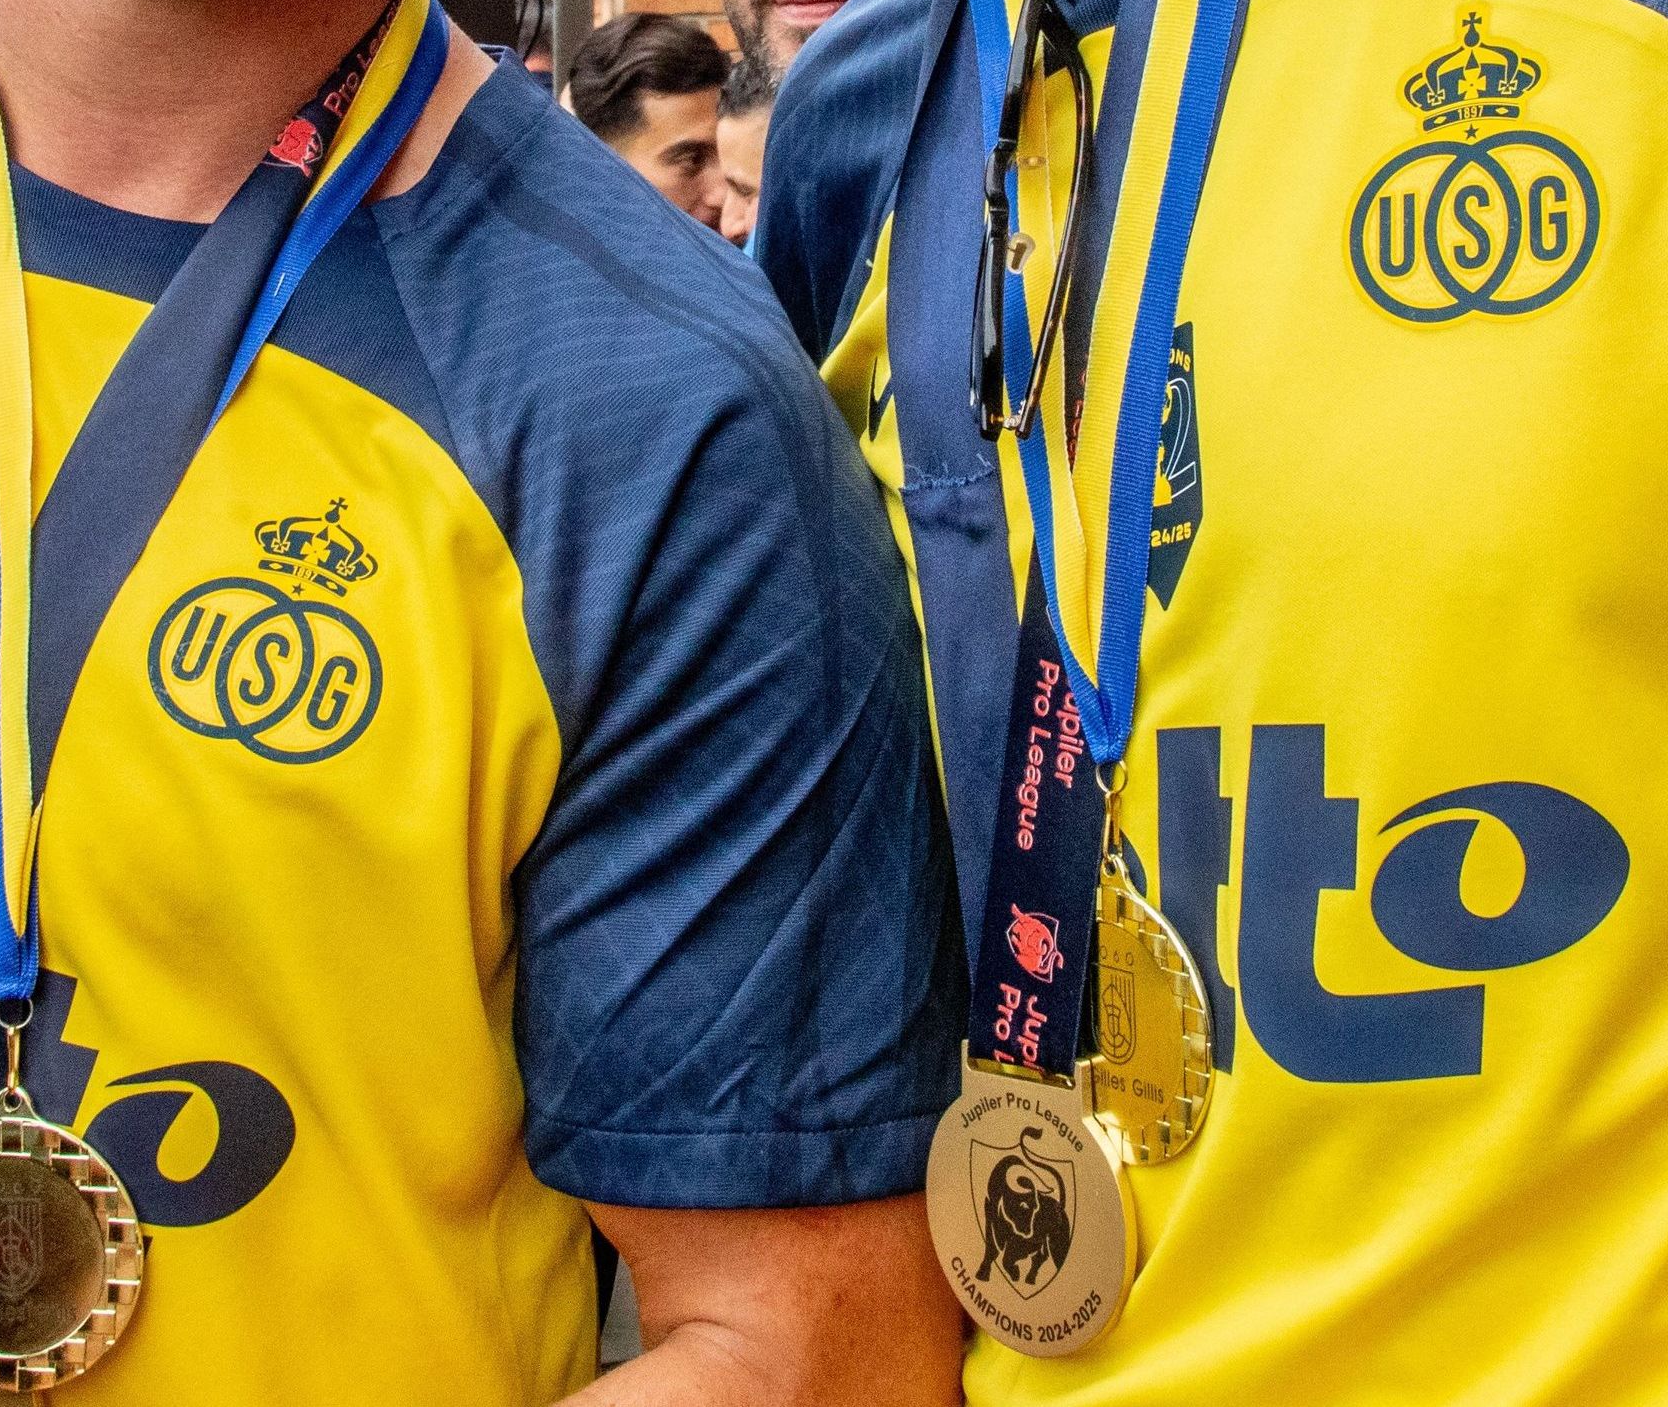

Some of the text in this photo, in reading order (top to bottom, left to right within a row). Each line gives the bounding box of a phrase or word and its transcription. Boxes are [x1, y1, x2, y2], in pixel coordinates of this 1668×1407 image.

[1457, 104, 1485, 120] 1897
[1378, 175, 1569, 278] USG
[292, 566, 318, 583] 1897
[169, 605, 358, 731] USG
[1017, 658, 1061, 851] Pro League
[1055, 692, 1085, 789] upiler
[995, 982, 1022, 1042] Pro
[960, 1092, 1084, 1153] Jupiler Pro League
[951, 1256, 1102, 1343] CHAMPIONS 2024-2025
